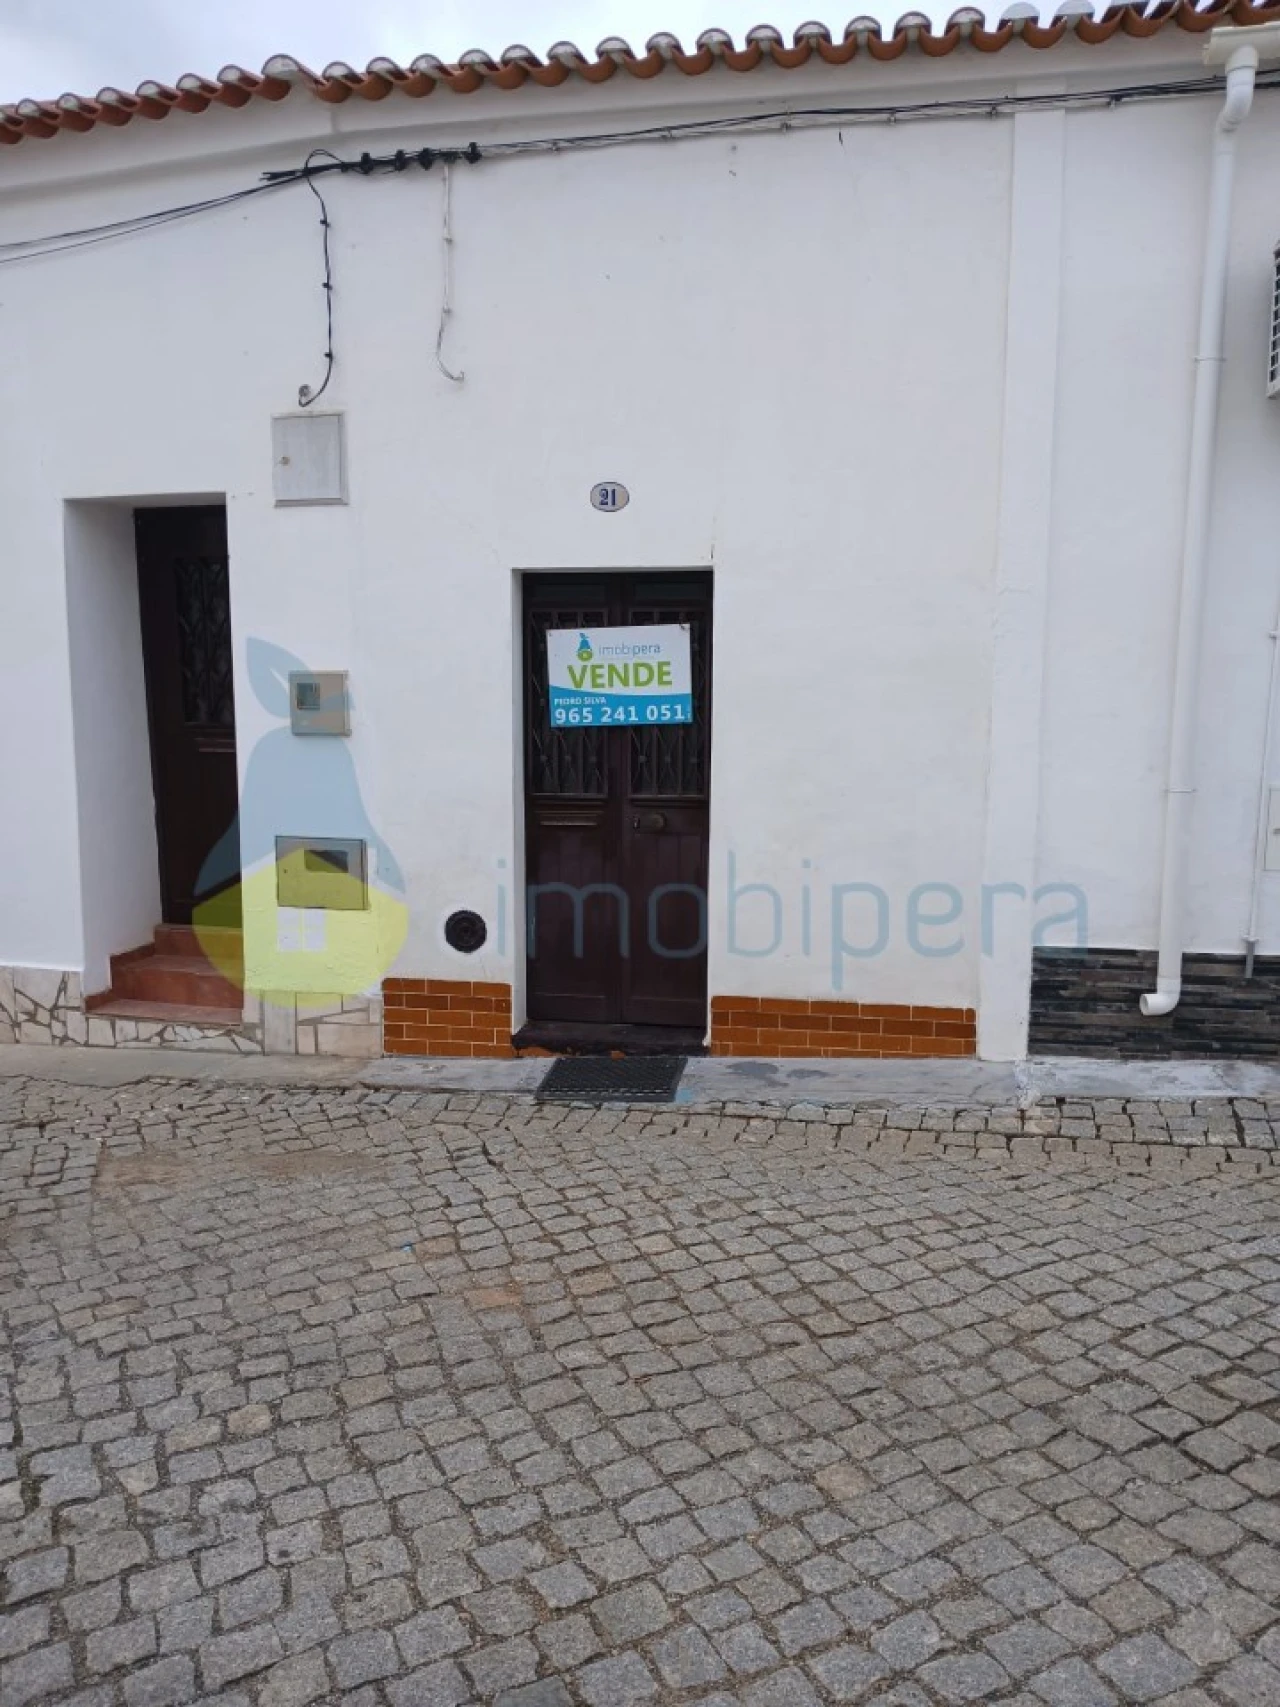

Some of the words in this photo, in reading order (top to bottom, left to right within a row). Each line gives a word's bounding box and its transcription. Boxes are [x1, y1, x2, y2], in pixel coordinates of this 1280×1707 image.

[599, 488, 616, 506] 21
[567, 661, 673, 689] VENDE
[554, 697, 582, 705] PEDRO
[584, 696, 607, 704] SILVA
[555, 707, 593, 724] 965
[600, 705, 639, 723] 241
[646, 703, 685, 721] 051
